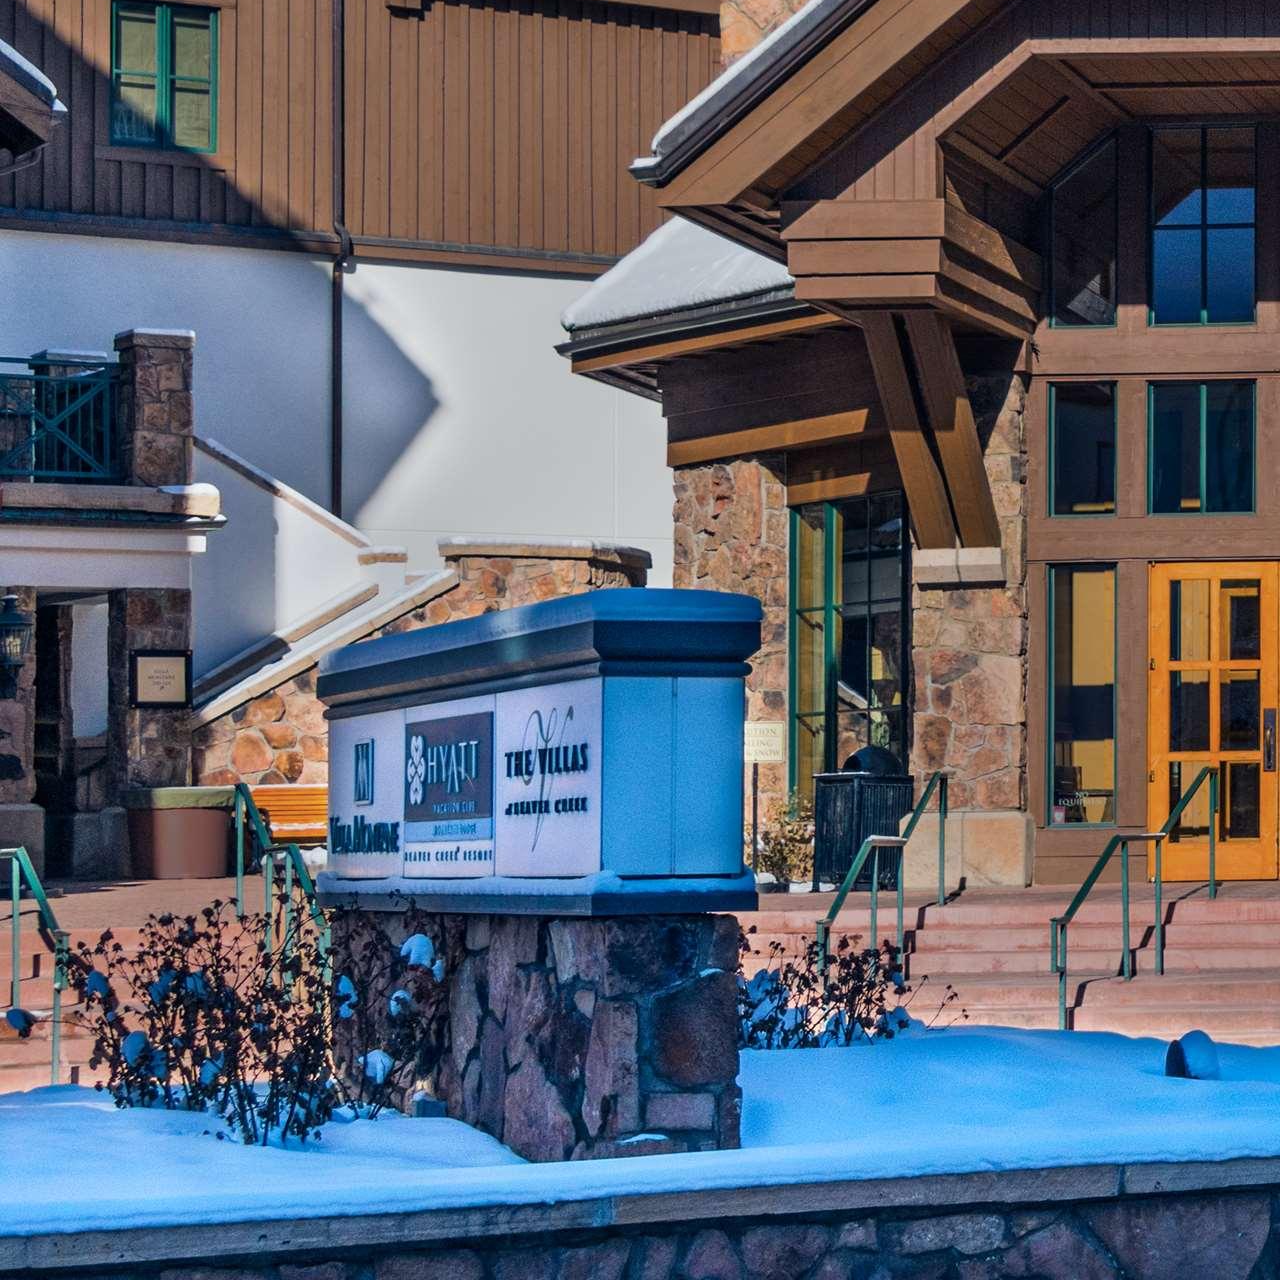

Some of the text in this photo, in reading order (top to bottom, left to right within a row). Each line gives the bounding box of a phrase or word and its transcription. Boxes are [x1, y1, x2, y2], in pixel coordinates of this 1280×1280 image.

[427, 741, 479, 794] HYATT
[504, 743, 588, 778] THE VILLAS
[554, 797, 588, 814] CREEK
